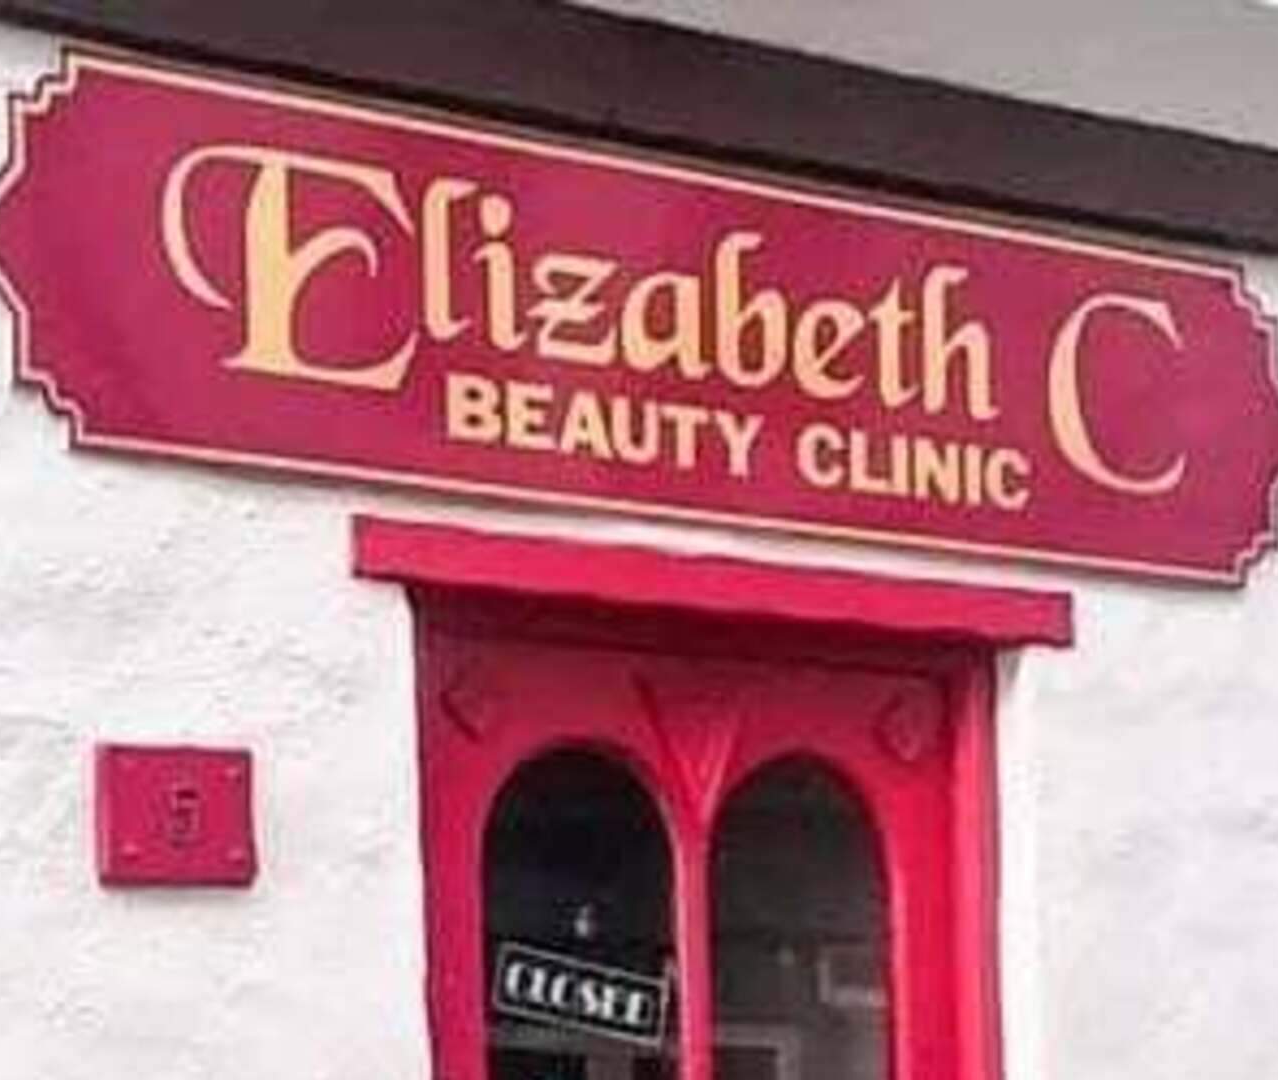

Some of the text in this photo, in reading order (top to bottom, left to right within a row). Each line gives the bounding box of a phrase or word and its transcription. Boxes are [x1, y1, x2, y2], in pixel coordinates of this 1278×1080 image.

[161, 143, 1187, 495] Elizabeth C
[447, 377, 1030, 511] BEAUTY CLINIC
[505, 961, 655, 1026] CLOSED
